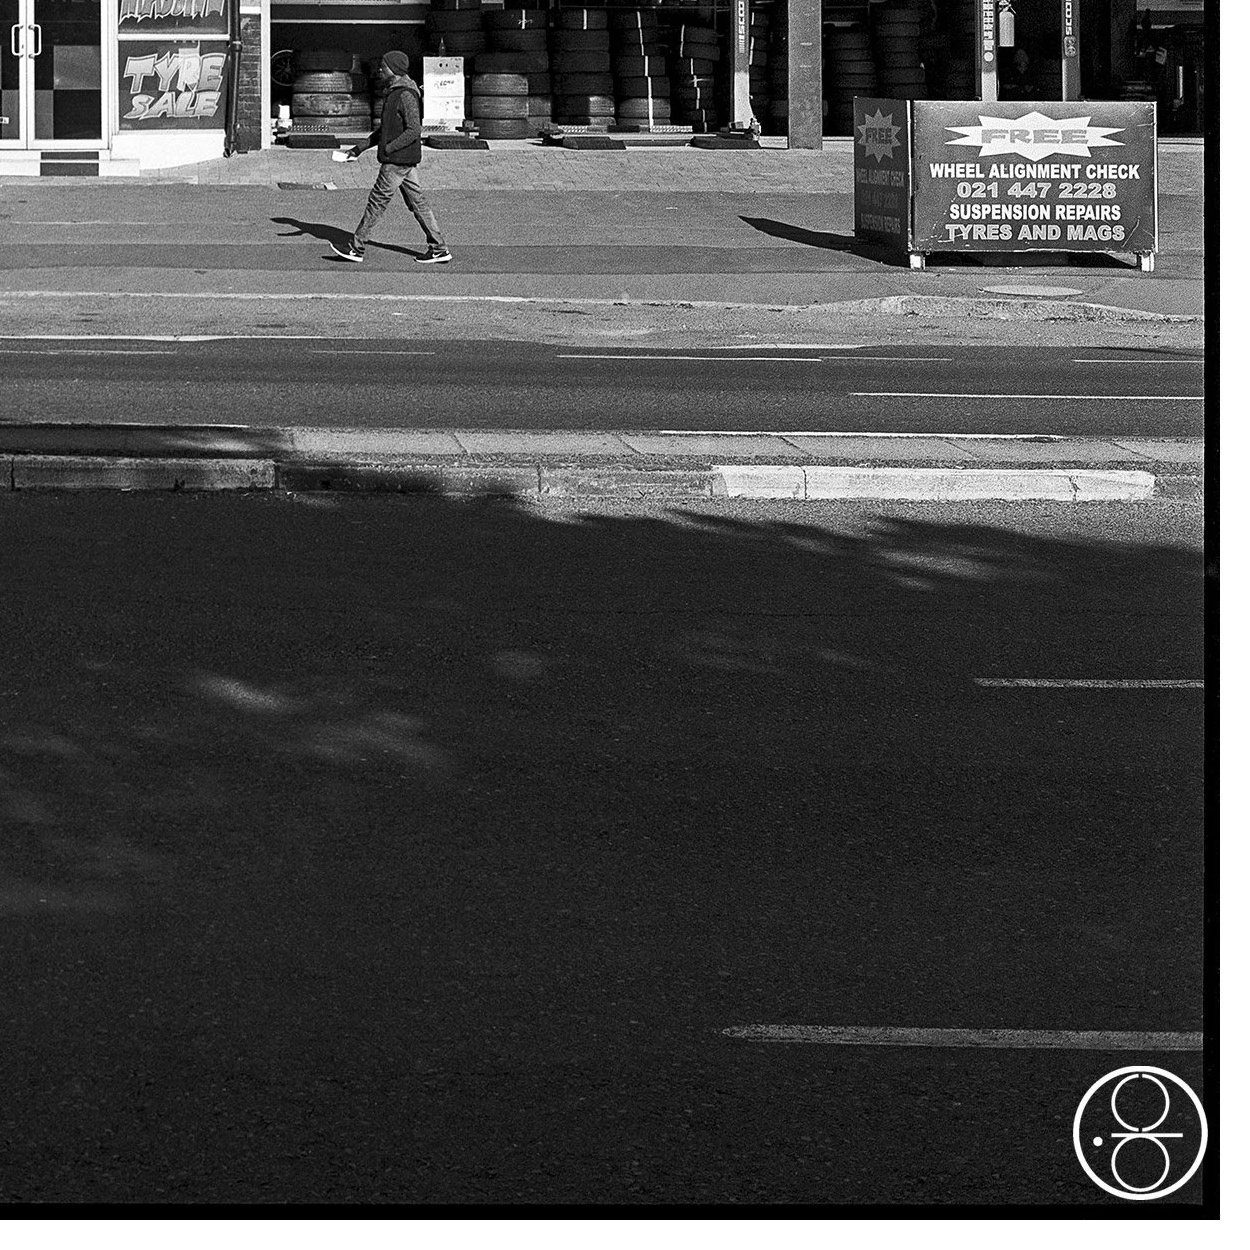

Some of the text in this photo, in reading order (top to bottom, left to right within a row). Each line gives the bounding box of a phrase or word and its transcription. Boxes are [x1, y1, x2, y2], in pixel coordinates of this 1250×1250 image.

[123, 52, 227, 94] TYRE
[123, 91, 222, 120] SALE
[981, 128, 1089, 145] FREE
[929, 163, 1141, 180] WHEEL ALIGNMENT CHECK
[956, 182, 1117, 199] 021 447 2228
[949, 203, 1121, 221] SUSPENSION REPAIRS
[945, 224, 1125, 241] TYRES AND MAGS
